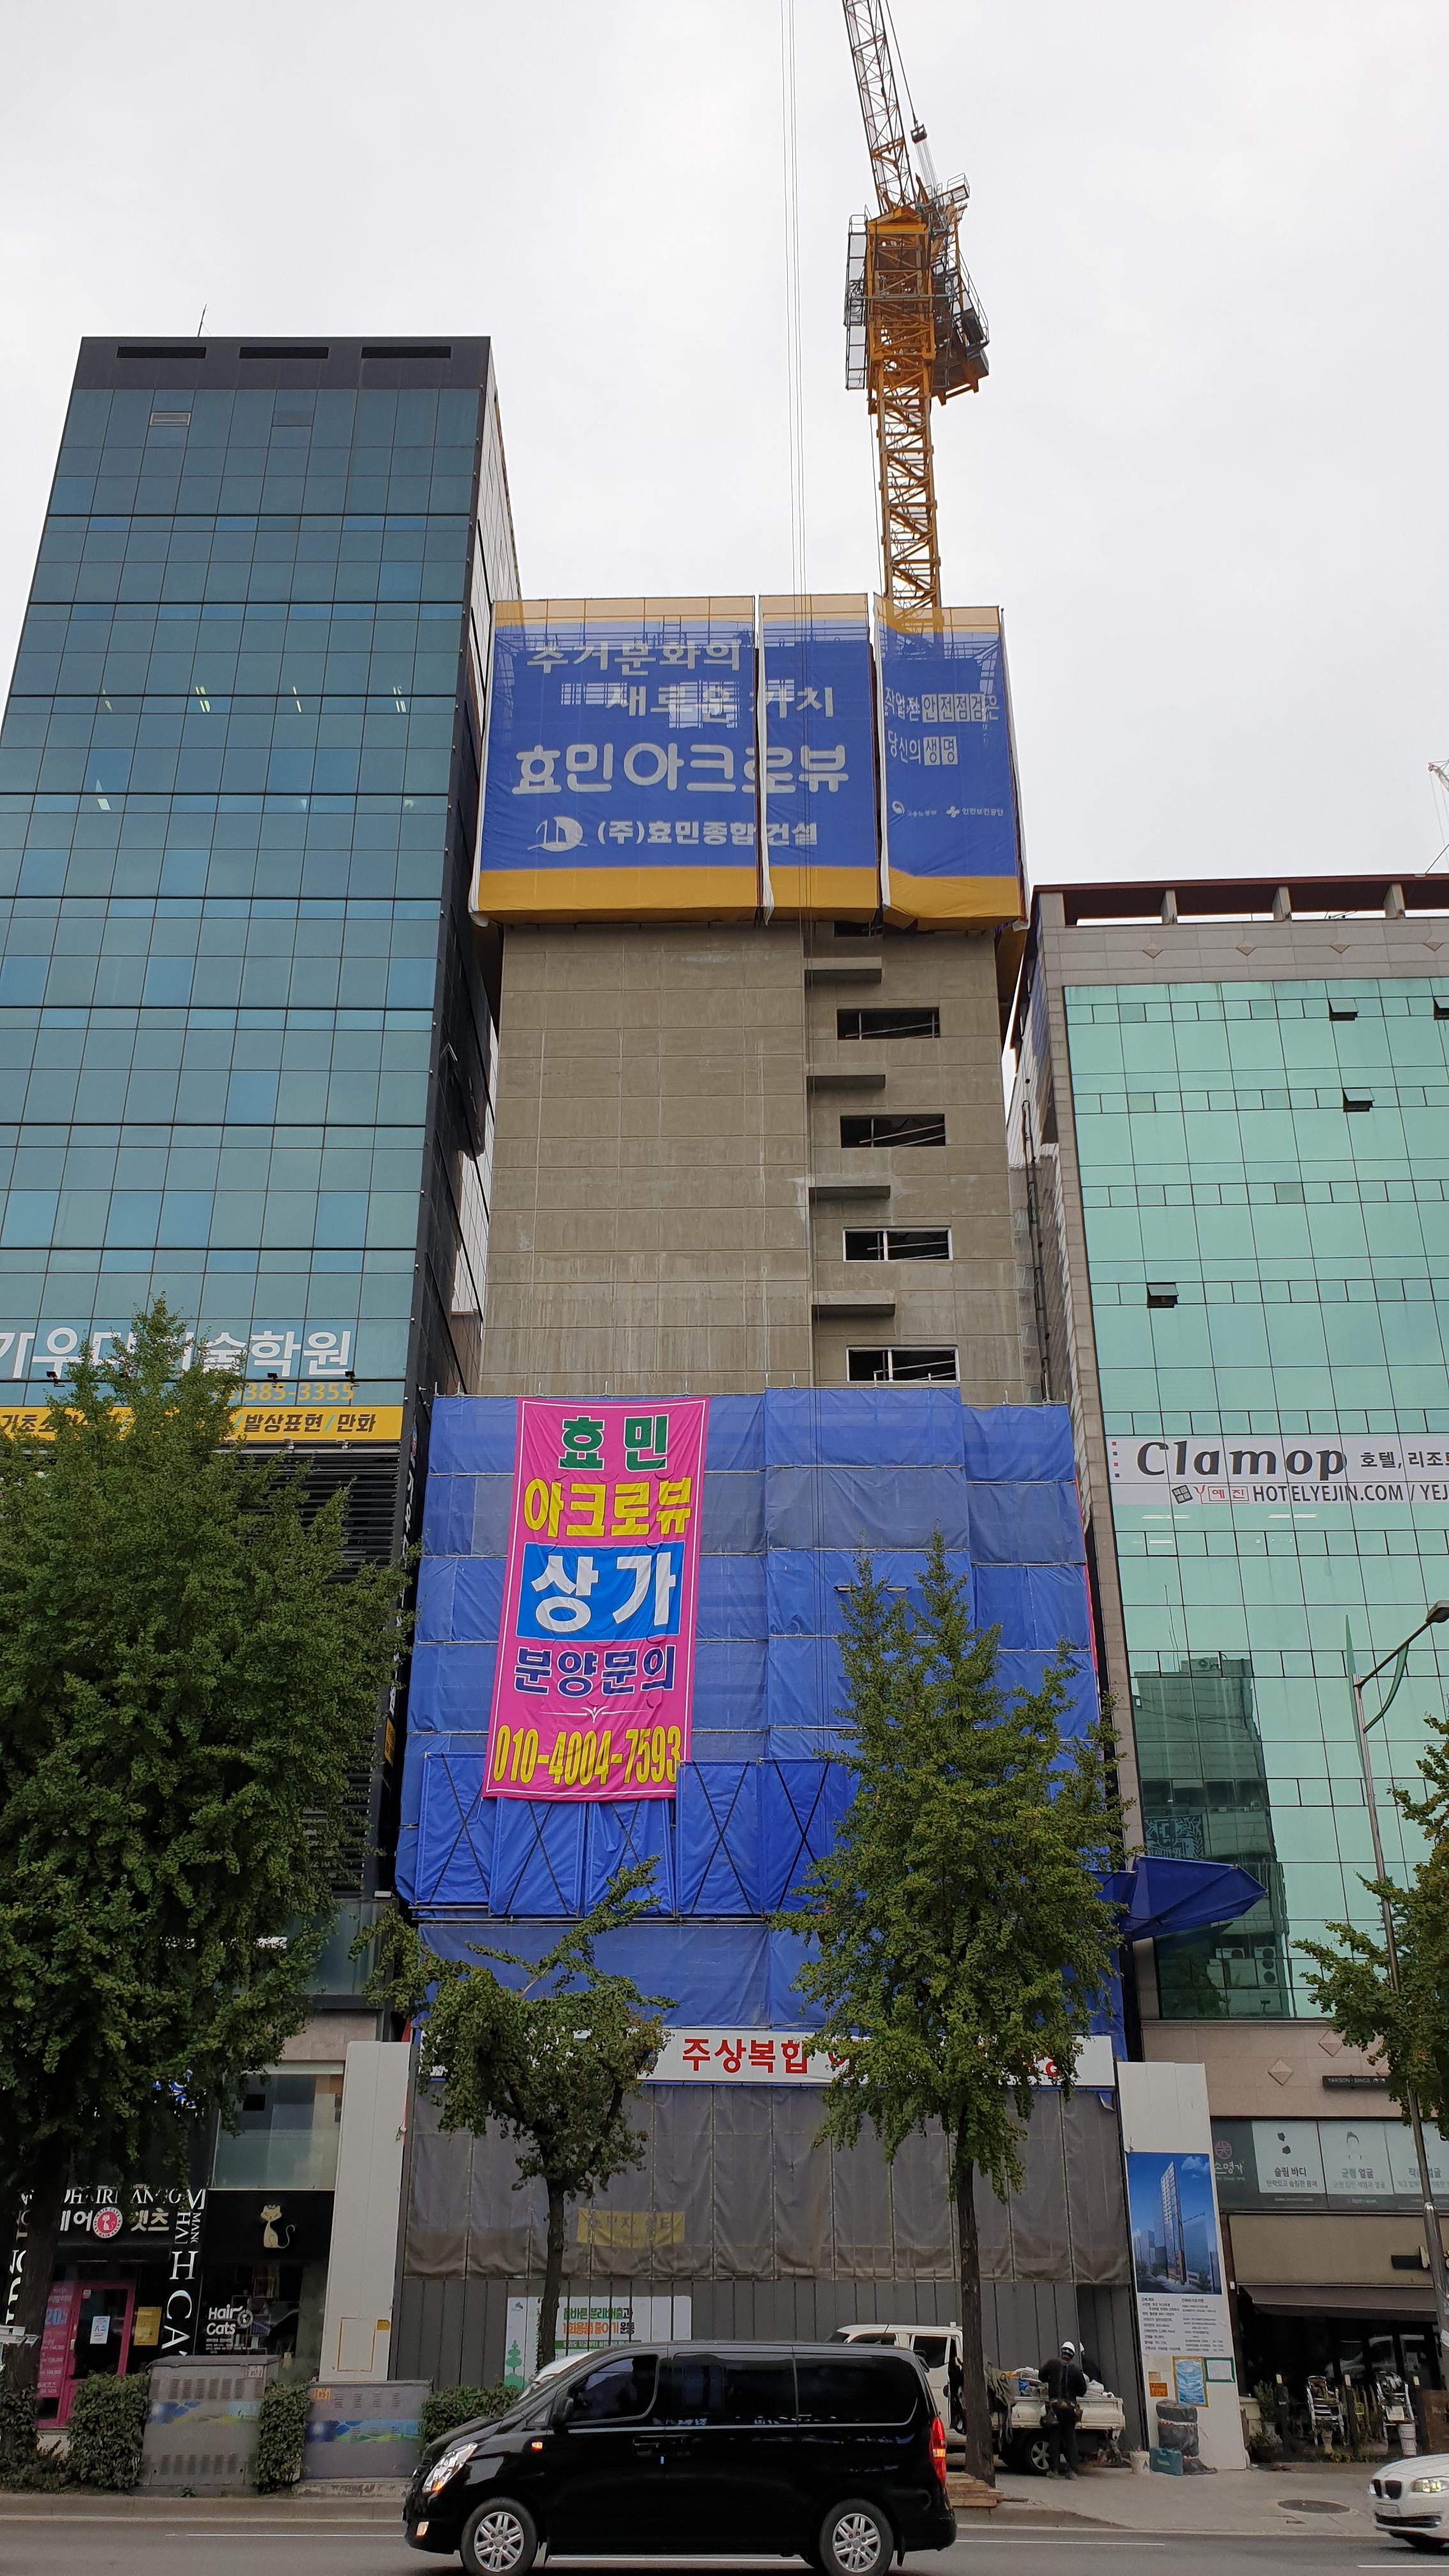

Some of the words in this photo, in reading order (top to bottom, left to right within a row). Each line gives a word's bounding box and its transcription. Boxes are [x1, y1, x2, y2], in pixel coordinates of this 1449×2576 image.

[527, 641, 740, 676] 주거문화의
[921, 694, 1000, 723] 안전점검은
[887, 730, 921, 765] 당신의
[923, 736, 958, 765] 생명
[512, 742, 849, 795] 효민아크로뷰
[243, 1414, 324, 1433] 발상표현
[337, 1414, 376, 1433] 만화
[1137, 1440, 1347, 1481] Clamop
[522, 1476, 692, 1538] 아크로뷰
[1211, 1489, 1245, 1499] 예진
[1253, 1484, 1404, 1502] HOTELYEJIN.COM
[530, 1551, 676, 1634] 상가
[513, 1644, 676, 1698] 분양문의
[492, 1724, 682, 1786] 010-4004-7593
[683, 2038, 808, 2074] 주상복합
[1274, 2166, 1289, 2177] 슬림
[1291, 2166, 1307, 2177] 바디
[206, 2322, 236, 2335] Cats
[208, 2304, 243, 2320] Hair
